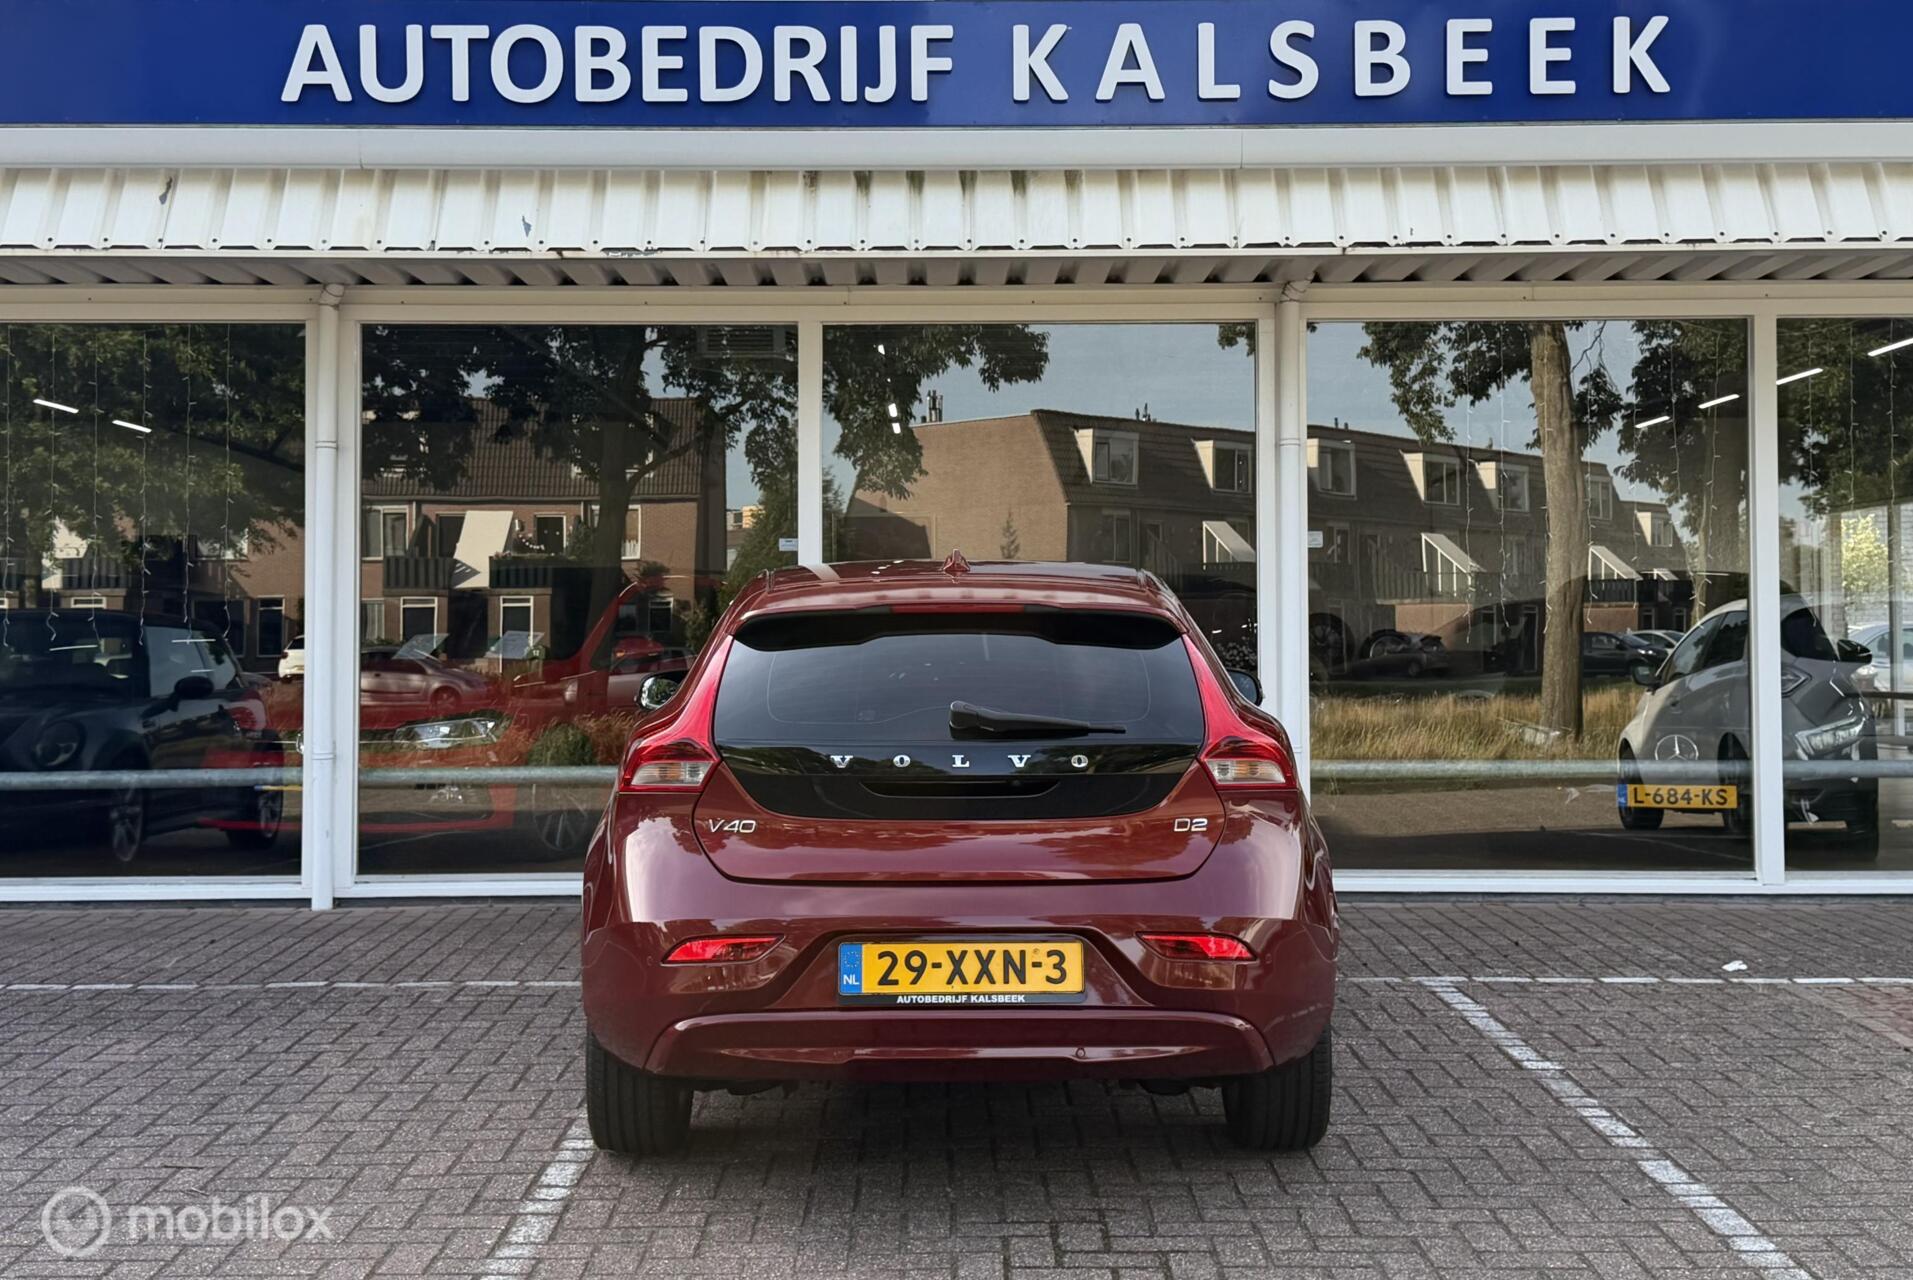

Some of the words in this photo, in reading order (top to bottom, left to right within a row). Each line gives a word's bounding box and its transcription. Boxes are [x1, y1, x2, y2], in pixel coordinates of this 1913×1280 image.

[281, 24, 954, 104] AUTOBEDRIJF
[1012, 15, 1671, 101] KALSBEEK
[830, 754, 1089, 769] VOLVO
[1633, 787, 1729, 806] L-684-KS
[709, 819, 756, 833] V40
[1174, 818, 1208, 832] D2
[877, 949, 1067, 986] 29-XXN-3
[843, 975, 860, 985] NL
[896, 994, 967, 1004] AUTOBEDRIJF
[970, 994, 1026, 1003] KALSBEEK
